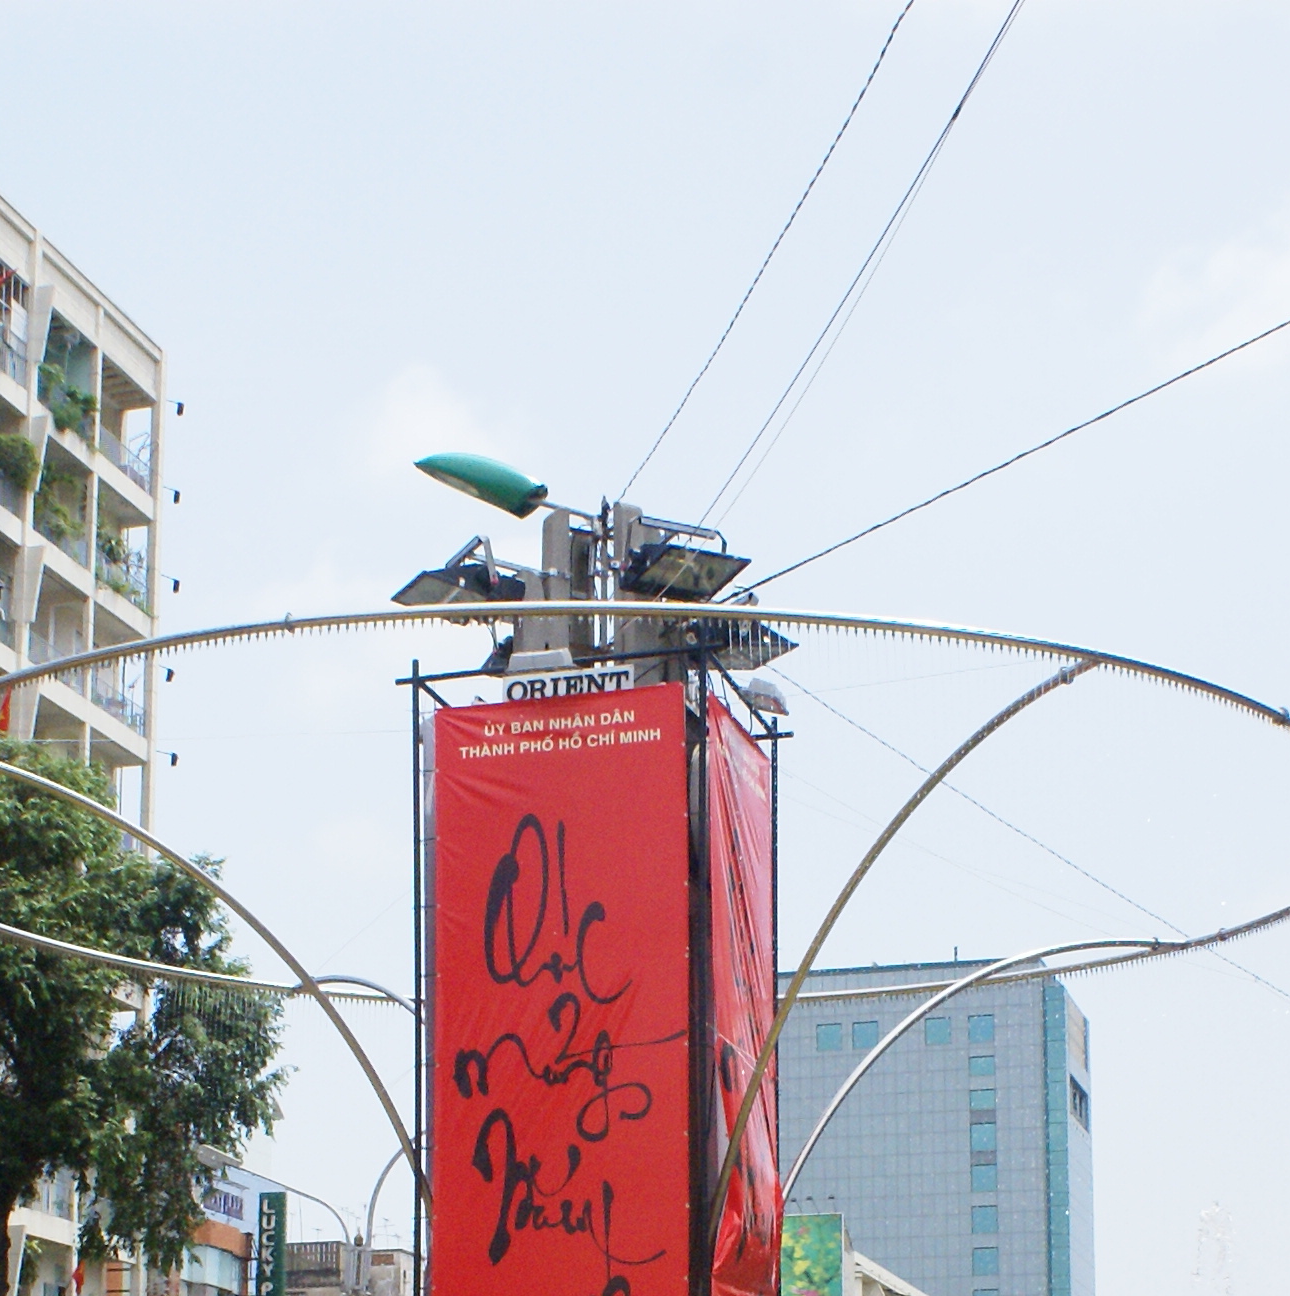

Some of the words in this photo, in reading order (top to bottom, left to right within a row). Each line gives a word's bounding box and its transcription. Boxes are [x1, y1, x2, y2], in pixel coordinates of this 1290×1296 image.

[506, 669, 630, 702] ORIENT
[484, 719, 506, 737] ỦY
[511, 718, 545, 735] BAN
[549, 711, 595, 731] NHÂN
[600, 709, 636, 726] DÂN
[460, 742, 515, 760] THÀNH
[520, 733, 554, 754] PHỐ
[559, 731, 583, 751] HỒ
[587, 729, 616, 748] CHÍ
[620, 728, 662, 745] MINH
[261, 1199, 276, 1277] LUCKY
